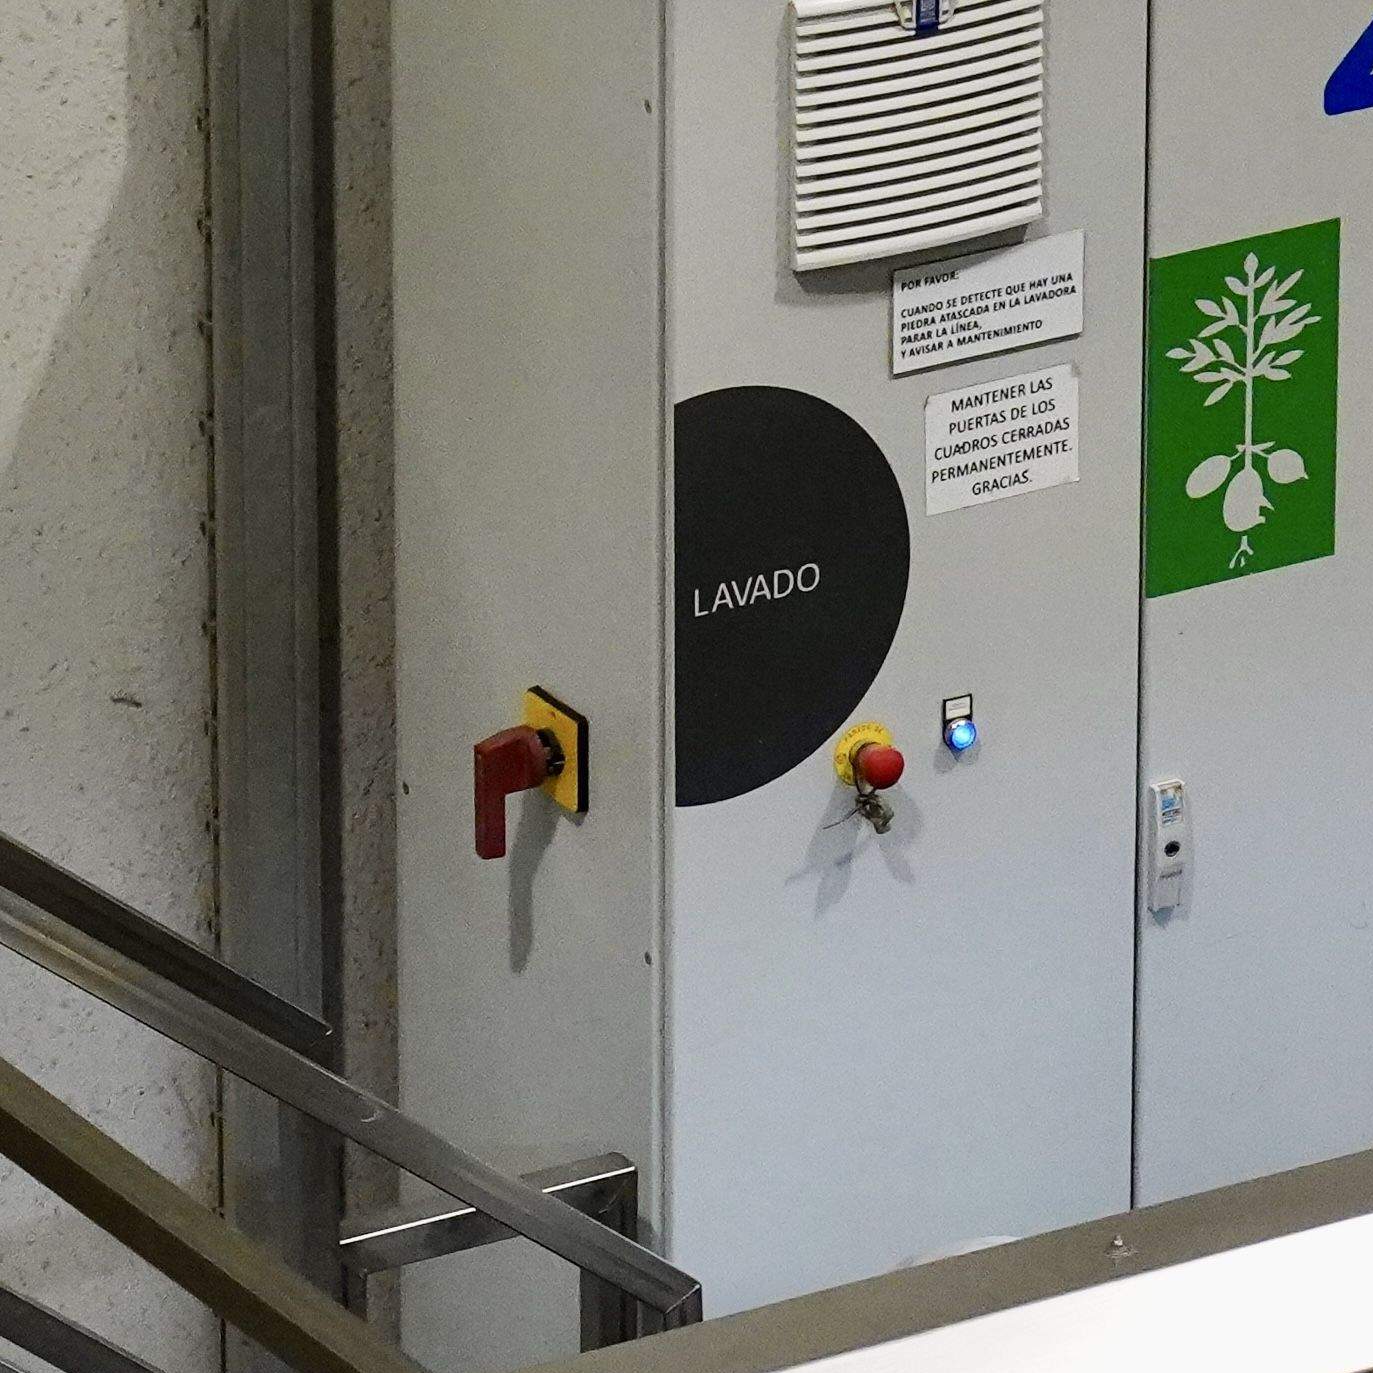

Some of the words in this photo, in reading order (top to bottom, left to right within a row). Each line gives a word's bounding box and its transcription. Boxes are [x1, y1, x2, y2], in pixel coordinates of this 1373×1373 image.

[901, 279, 922, 292] POR
[924, 270, 960, 286] FAVOR:
[901, 301, 944, 318] CUANDO
[946, 297, 958, 309] SE
[960, 287, 1003, 306] DETECTE
[1005, 282, 1026, 296] QUE
[1029, 277, 1049, 291] HAY
[1051, 272, 1073, 286] UNA
[901, 315, 936, 332] PIEDRA
[939, 304, 990, 323] ATASCADA
[993, 300, 1006, 312] EN
[1009, 296, 1021, 308] LA
[1024, 285, 1077, 305] LAVADORA
[901, 330, 933, 346] PARAR
[935, 325, 948, 338] LA
[901, 349, 907, 359] Y
[909, 340, 944, 357] AVISAR
[946, 339, 954, 349] A
[957, 319, 1043, 346] MANTENIMIENTO
[951, 383, 1026, 413] MANTENER
[1030, 377, 1053, 394] LAS
[949, 410, 1007, 435] PUERTAS
[1010, 404, 1028, 421] DE
[1032, 398, 1056, 416] LOS
[934, 434, 998, 461] CUADROS
[1001, 416, 1071, 445] CERRADAS
[931, 438, 1073, 484] PERMANENTEMENTE.
[972, 468, 1033, 496] GRACIAS.
[694, 562, 822, 618] LAVADO
